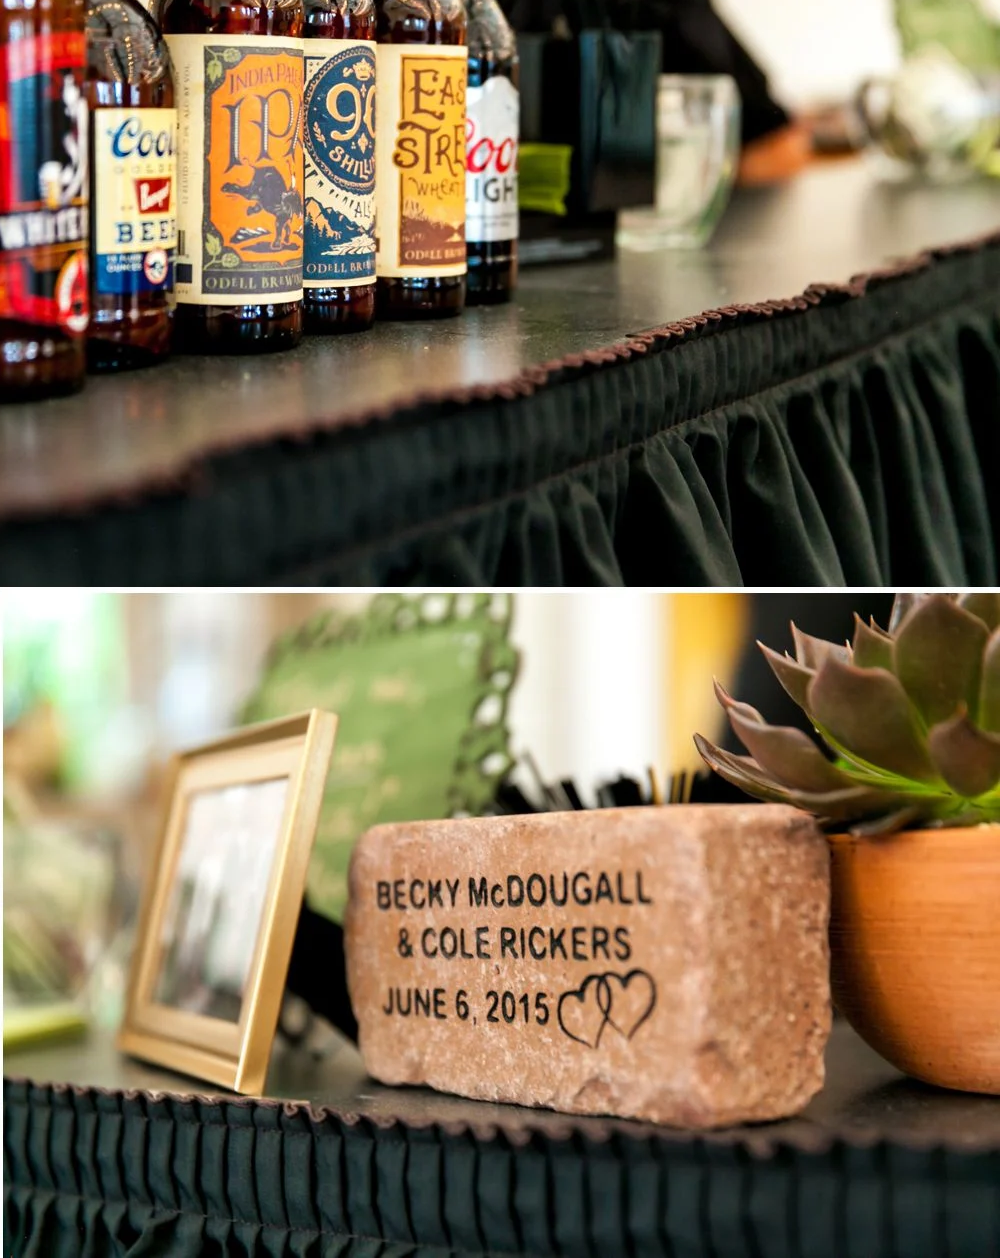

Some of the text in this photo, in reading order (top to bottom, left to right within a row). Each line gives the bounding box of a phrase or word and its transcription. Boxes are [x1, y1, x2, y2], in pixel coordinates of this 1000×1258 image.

[229, 65, 274, 94] INDIA
[205, 276, 257, 290] ODELL
[306, 262, 347, 274] ODELL
[376, 871, 653, 911] BECKY McDOUGALL
[397, 926, 632, 961] & COLE RICKERS
[382, 987, 550, 1026] JUNE 6, 2015
